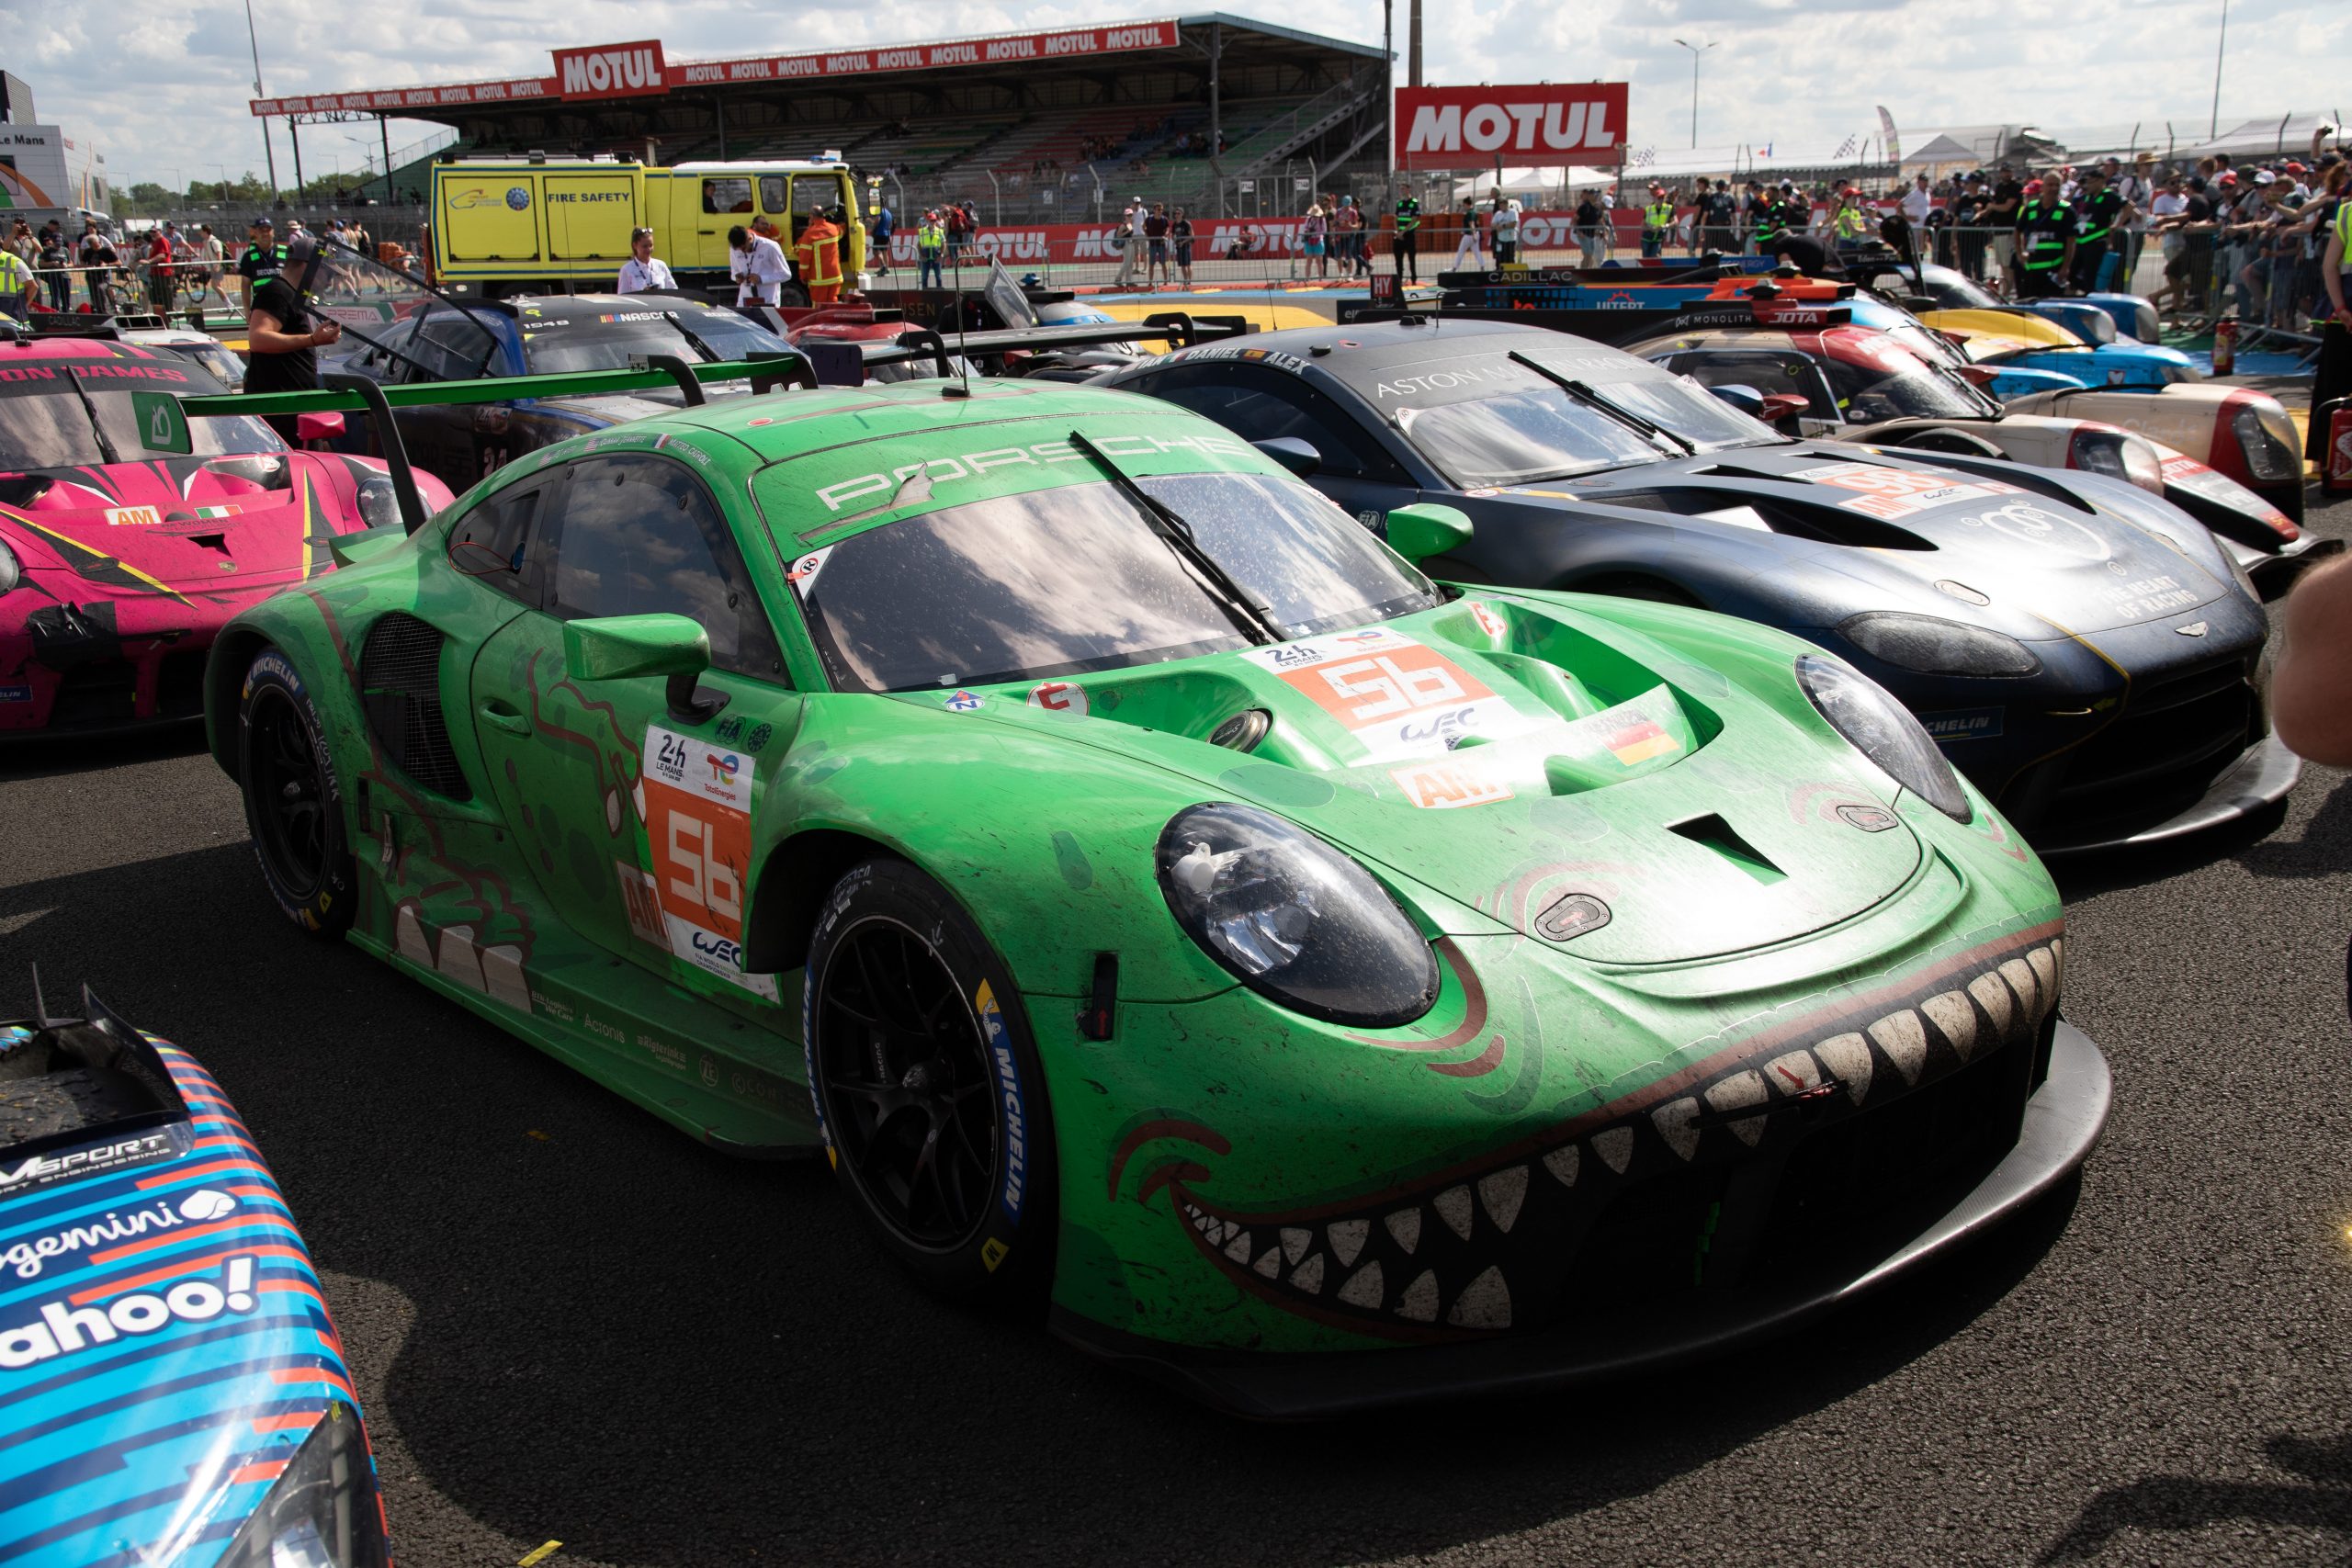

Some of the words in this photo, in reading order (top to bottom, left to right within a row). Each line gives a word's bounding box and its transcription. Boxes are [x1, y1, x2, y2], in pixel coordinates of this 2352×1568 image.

[685, 65, 725, 83] MOTUL
[730, 62, 771, 80] MOTUL
[778, 58, 820, 76] MOTUL
[827, 53, 870, 73] MOTUL
[877, 50, 923, 69] MOTUL
[931, 44, 978, 64] MOTUL
[986, 39, 1036, 59] MOTUL
[1045, 33, 1098, 54] MOTUL
[1106, 27, 1162, 49] MOTUL
[563, 49, 662, 94] MOTUL
[254, 102, 279, 113] MOTUL
[283, 99, 309, 112] MOTUL
[312, 96, 339, 109] MOTUL
[343, 95, 369, 108] MOTUL
[373, 93, 402, 106] MOTUL
[407, 90, 436, 105] MOTUL
[440, 87, 470, 102] MOTUL
[475, 85, 506, 99] MOTUL
[511, 81, 544, 96] MOTUL
[15, 134, 45, 145] Mans
[1406, 100, 1616, 152] MOTUL
[548, 193, 577, 203] FIRE
[581, 192, 630, 203] SAFETY
[977, 231, 1048, 259] OTUL
[1210, 223, 1306, 253] MOTU
[1374, 276, 1392, 294] HY
[1488, 271, 1574, 283] CADILLAC
[326, 309, 379, 321] PREMA
[1693, 314, 1752, 323] MONOLITH
[1768, 311, 1818, 323] JOTA
[0, 367, 56, 382] ON
[61, 365, 188, 382] DAMES
[1184, 347, 1240, 361] DANIEL
[1262, 352, 1311, 375] ALEX
[1377, 368, 1485, 399] ASTON
[816, 435, 1255, 511] PORSCHE
[1834, 469, 1946, 494] 98
[1923, 488, 1962, 500] WEC
[118, 509, 155, 525] AM
[2127, 576, 2180, 596] HEART
[2116, 602, 2142, 618] OF
[2139, 590, 2199, 613] RACING
[1265, 644, 1317, 663] 24h
[1292, 654, 1324, 664] MANS
[253, 655, 300, 693] MICHELIN
[1317, 656, 1468, 721] 56
[1400, 706, 1479, 743] WEC
[1925, 716, 1991, 733] CHELIN
[658, 734, 686, 769] 24h
[656, 761, 665, 771] LE
[664, 765, 684, 778] MANS
[705, 784, 736, 801] TotalEnergies
[668, 809, 741, 923] 56
[625, 875, 668, 939] AM
[583, 1013, 626, 1043] Acronis
[995, 1047, 1024, 1212] MICHELIN
[39, 1147, 172, 1183] ENGINEERING
[0, 1201, 185, 1280] gemini
[0, 1258, 254, 1367] ahoo!
